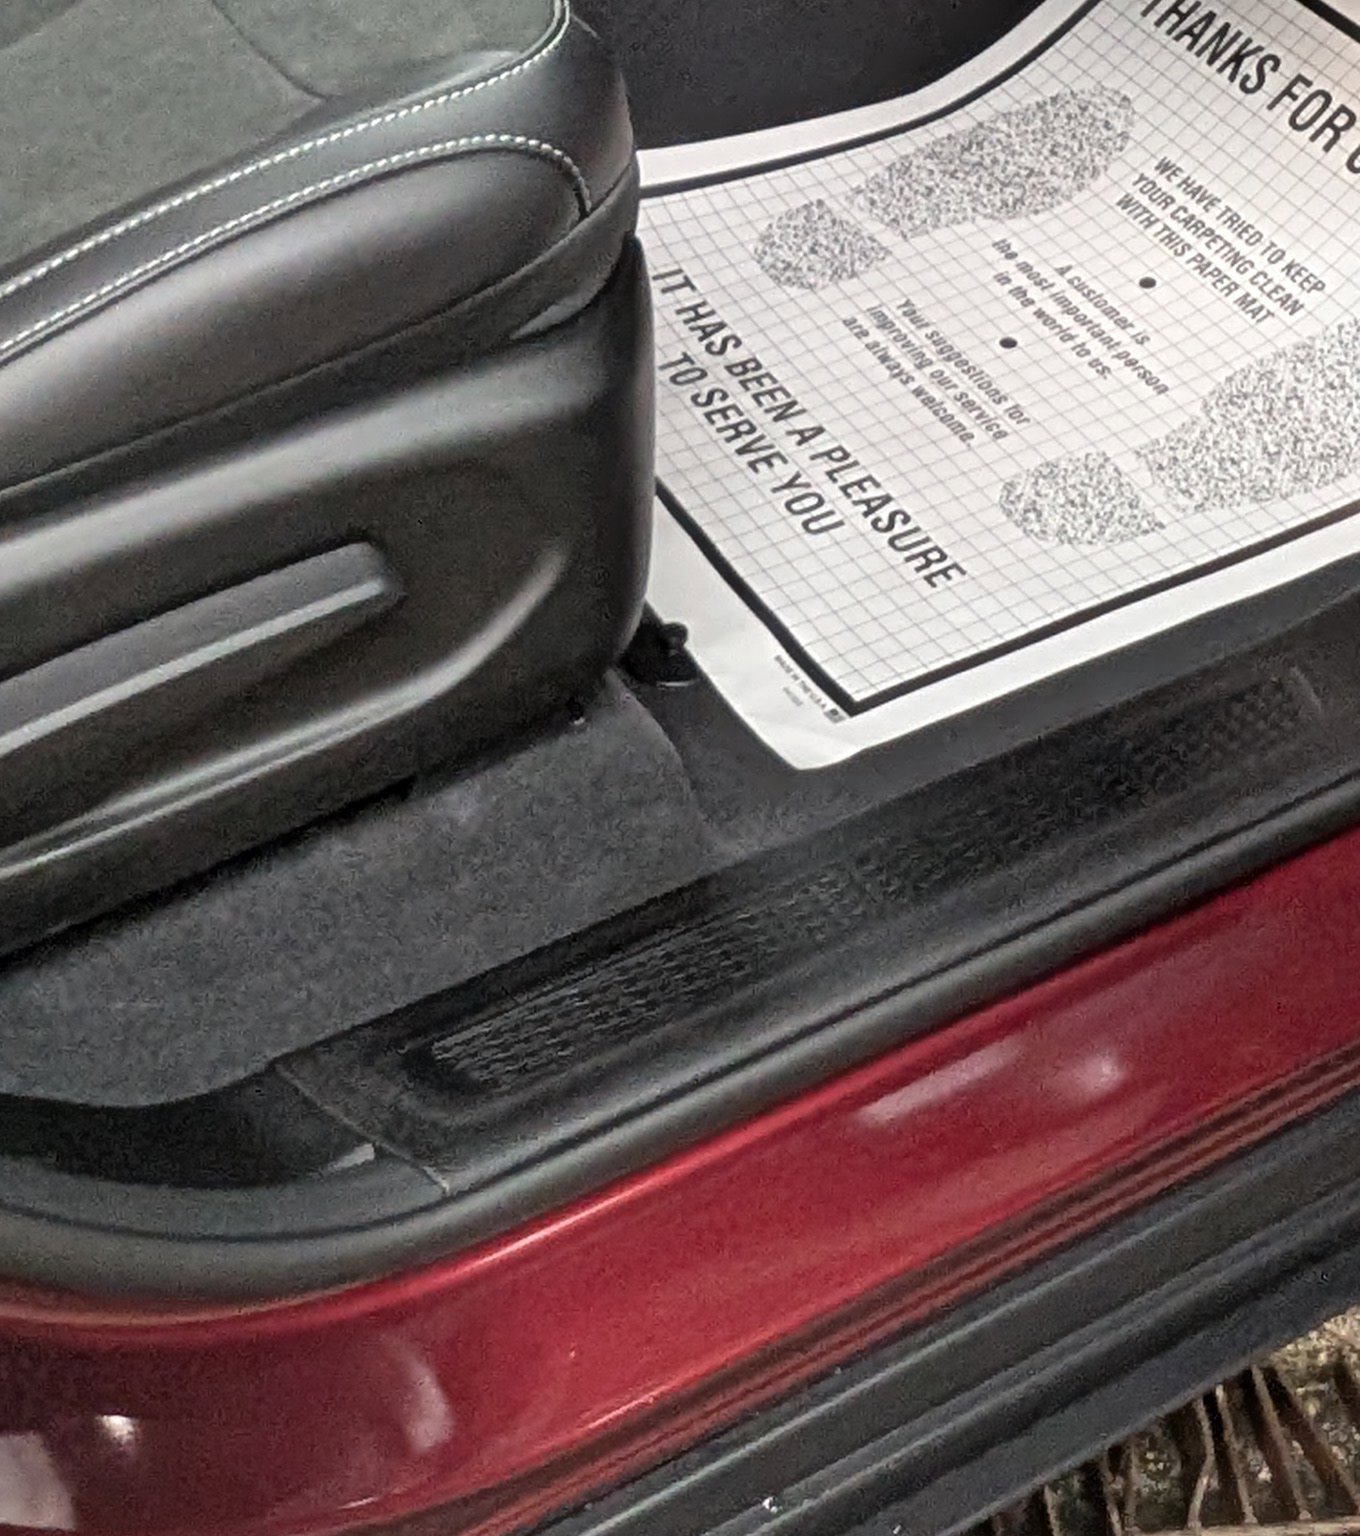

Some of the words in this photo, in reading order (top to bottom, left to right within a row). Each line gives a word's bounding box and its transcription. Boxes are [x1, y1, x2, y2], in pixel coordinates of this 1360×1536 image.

[1267, 74, 1356, 153] FOR
[1116, 193, 1160, 229] WITH
[1153, 223, 1192, 257] THIS
[1186, 253, 1240, 297] PAPER
[1234, 292, 1274, 323] MAT
[1132, 173, 1176, 210] YOUR
[1170, 206, 1255, 275] CARPETING
[1250, 271, 1304, 316] CLEAN
[1154, 156, 1183, 182] WE
[1177, 177, 1222, 212] HAVE
[1216, 206, 1263, 246] TRIED
[1260, 241, 1286, 264] TO
[1281, 259, 1326, 293] KEEP
[897, 299, 930, 330] Your
[925, 330, 1008, 405] suggestions
[1003, 403, 1031, 425] for
[992, 238, 1018, 260] the
[1016, 261, 1055, 291] most
[1049, 290, 1121, 350] important
[1111, 351, 1169, 395] person
[993, 271, 1012, 286] in
[1008, 286, 1035, 307] the
[1033, 308, 1079, 342] world
[1071, 342, 1091, 357] to
[1087, 358, 1111, 379] us.
[1055, 265, 1073, 276] A
[1067, 276, 1135, 330] customer
[1131, 330, 1150, 345] is
[652, 269, 696, 293] IT
[675, 300, 742, 355] HAS
[724, 357, 807, 422] BEEN
[786, 426, 826, 446] A
[809, 445, 967, 588] PLEASURE
[843, 317, 870, 339] are
[865, 341, 915, 385] always
[912, 385, 975, 448] welcome.
[866, 305, 933, 370] improving
[930, 369, 959, 391] our
[953, 392, 1008, 440] service
[658, 352, 708, 386] TO
[691, 388, 789, 474] SERVE
[770, 471, 845, 534] YOU
